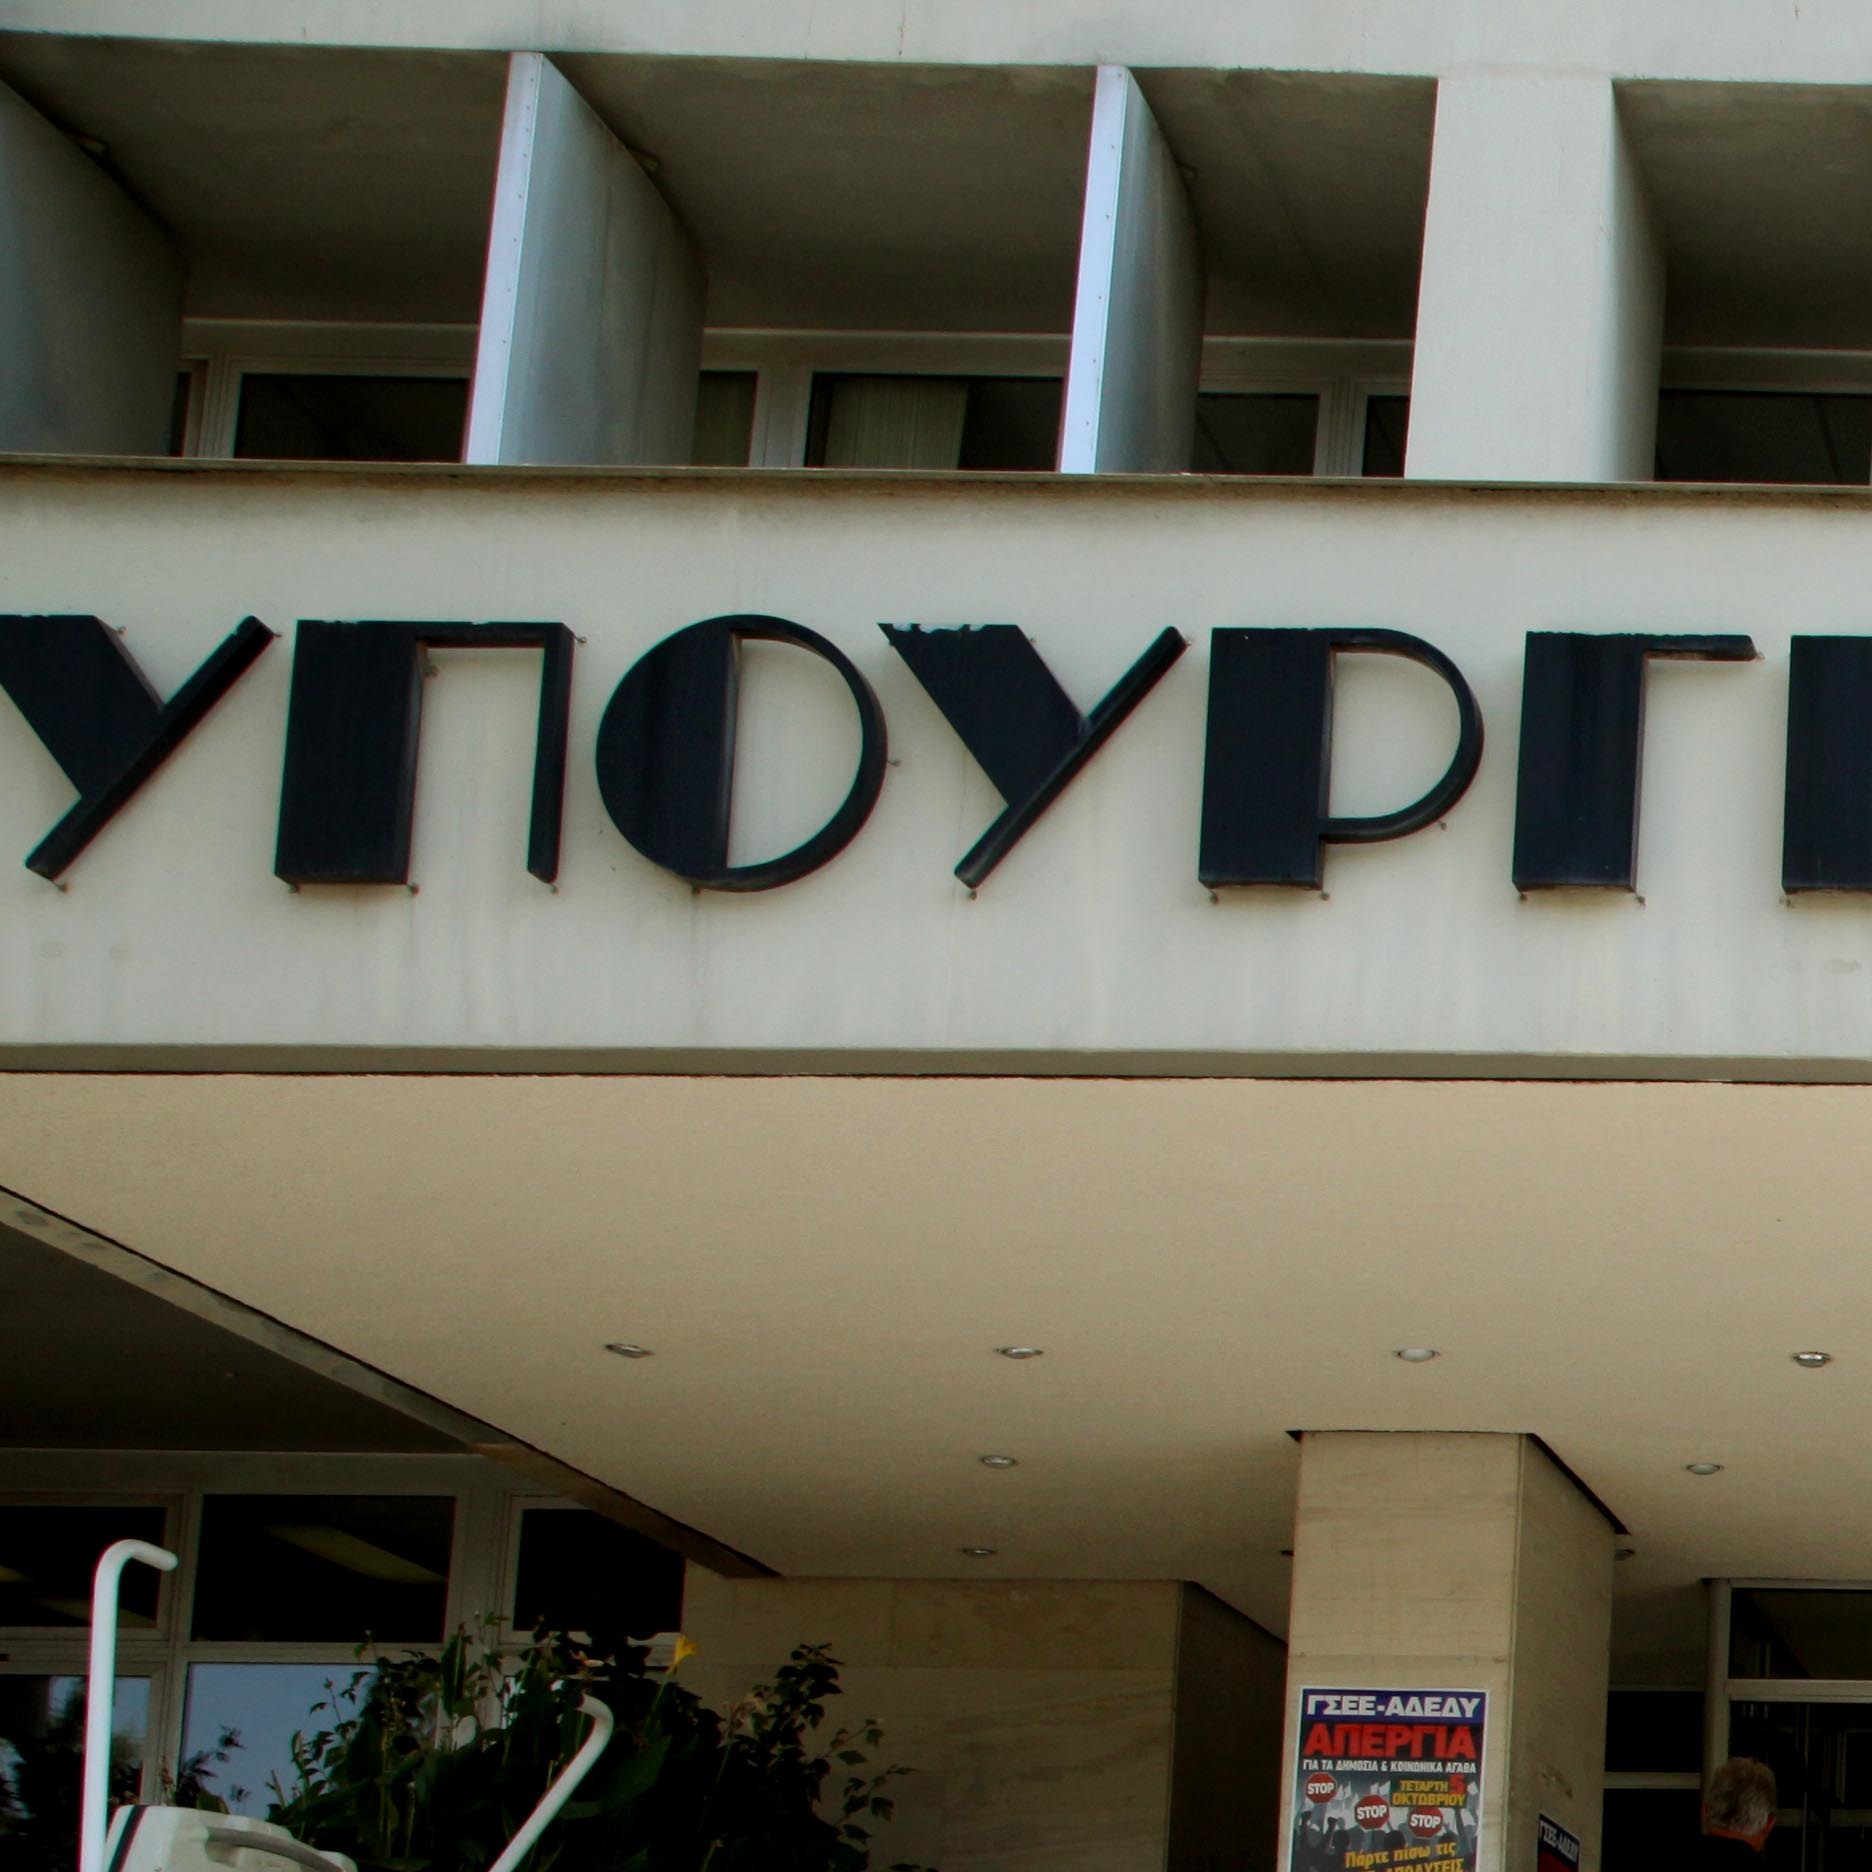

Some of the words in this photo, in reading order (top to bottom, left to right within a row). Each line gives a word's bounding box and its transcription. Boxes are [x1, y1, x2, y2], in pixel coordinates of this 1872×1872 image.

[1306, 1694, 1481, 1718] ΓΣΕΕ-ΑΔΕΔΥ
[1302, 1722, 1478, 1760] ΑΠΕΡΓΙΑ
[1302, 1759, 1320, 1771] ΓΙΑ
[1321, 1759, 1333, 1771] ΤΑ
[1307, 1782, 1335, 1795] STOP
[1400, 1780, 1448, 1792] ΤΕΤΑΡΤΗ
[1449, 1773, 1466, 1796] 5
[1391, 1793, 1467, 1806] ΟΚΤΩΒΡΙΟΥ
[1356, 1804, 1387, 1819] STOP
[1410, 1813, 1441, 1828] STOP
